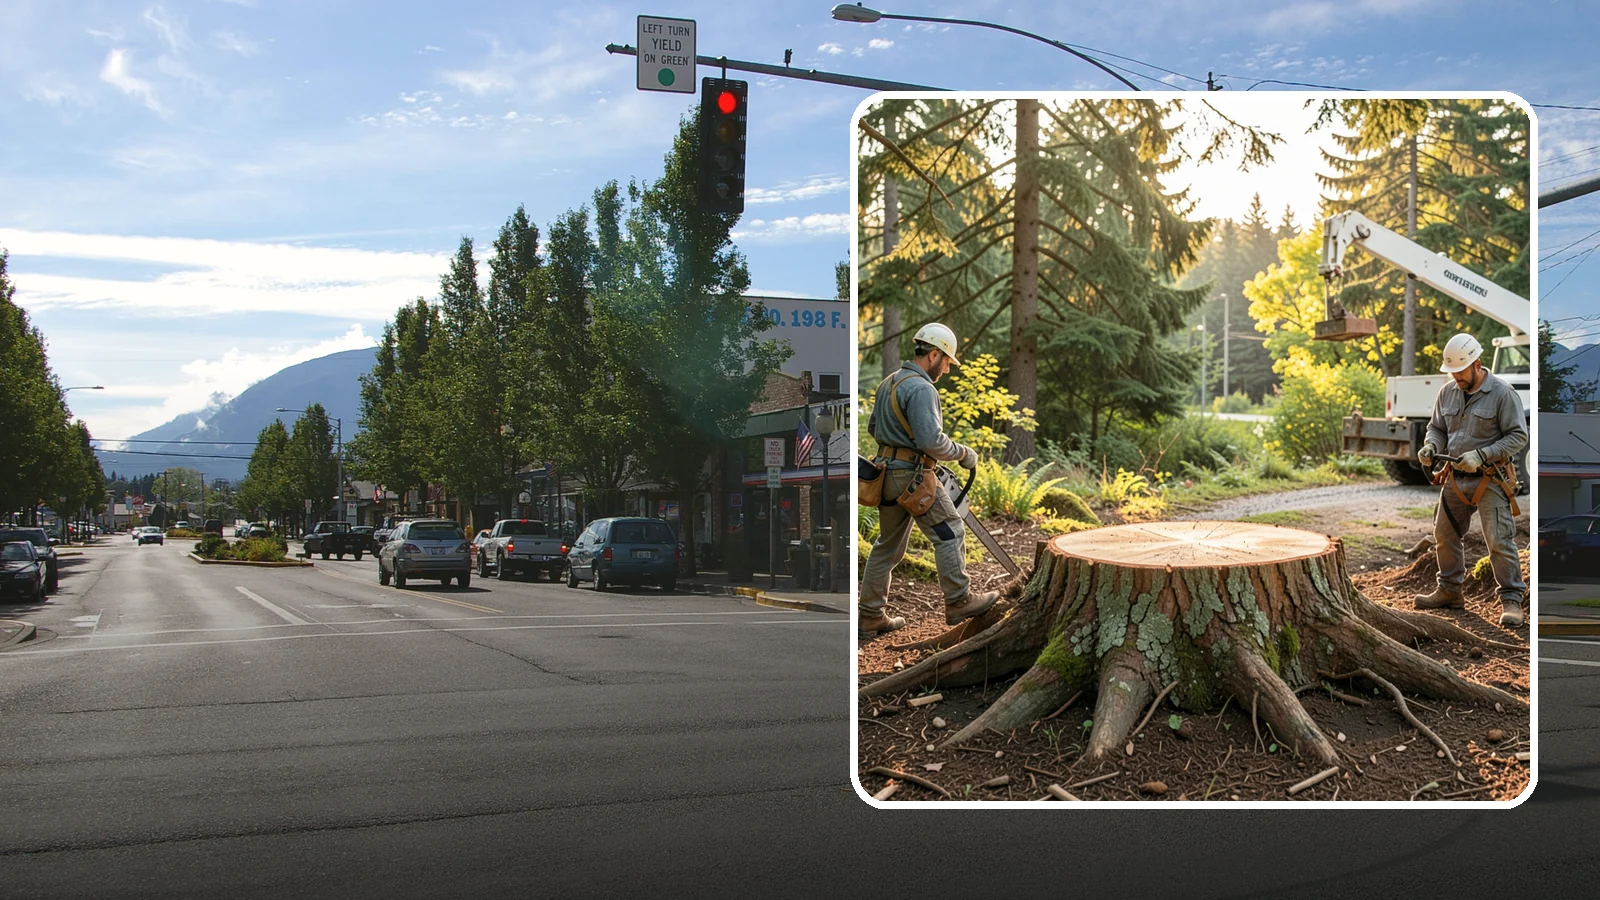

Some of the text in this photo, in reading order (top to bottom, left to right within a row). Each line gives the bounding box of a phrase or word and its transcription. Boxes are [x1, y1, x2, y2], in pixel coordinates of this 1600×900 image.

[642, 23, 690, 36] LEFT TURN
[652, 37, 682, 52] YIELD
[643, 53, 689, 66] ON GREEN
[791, 309, 826, 328] 198
[831, 311, 847, 329] F.
